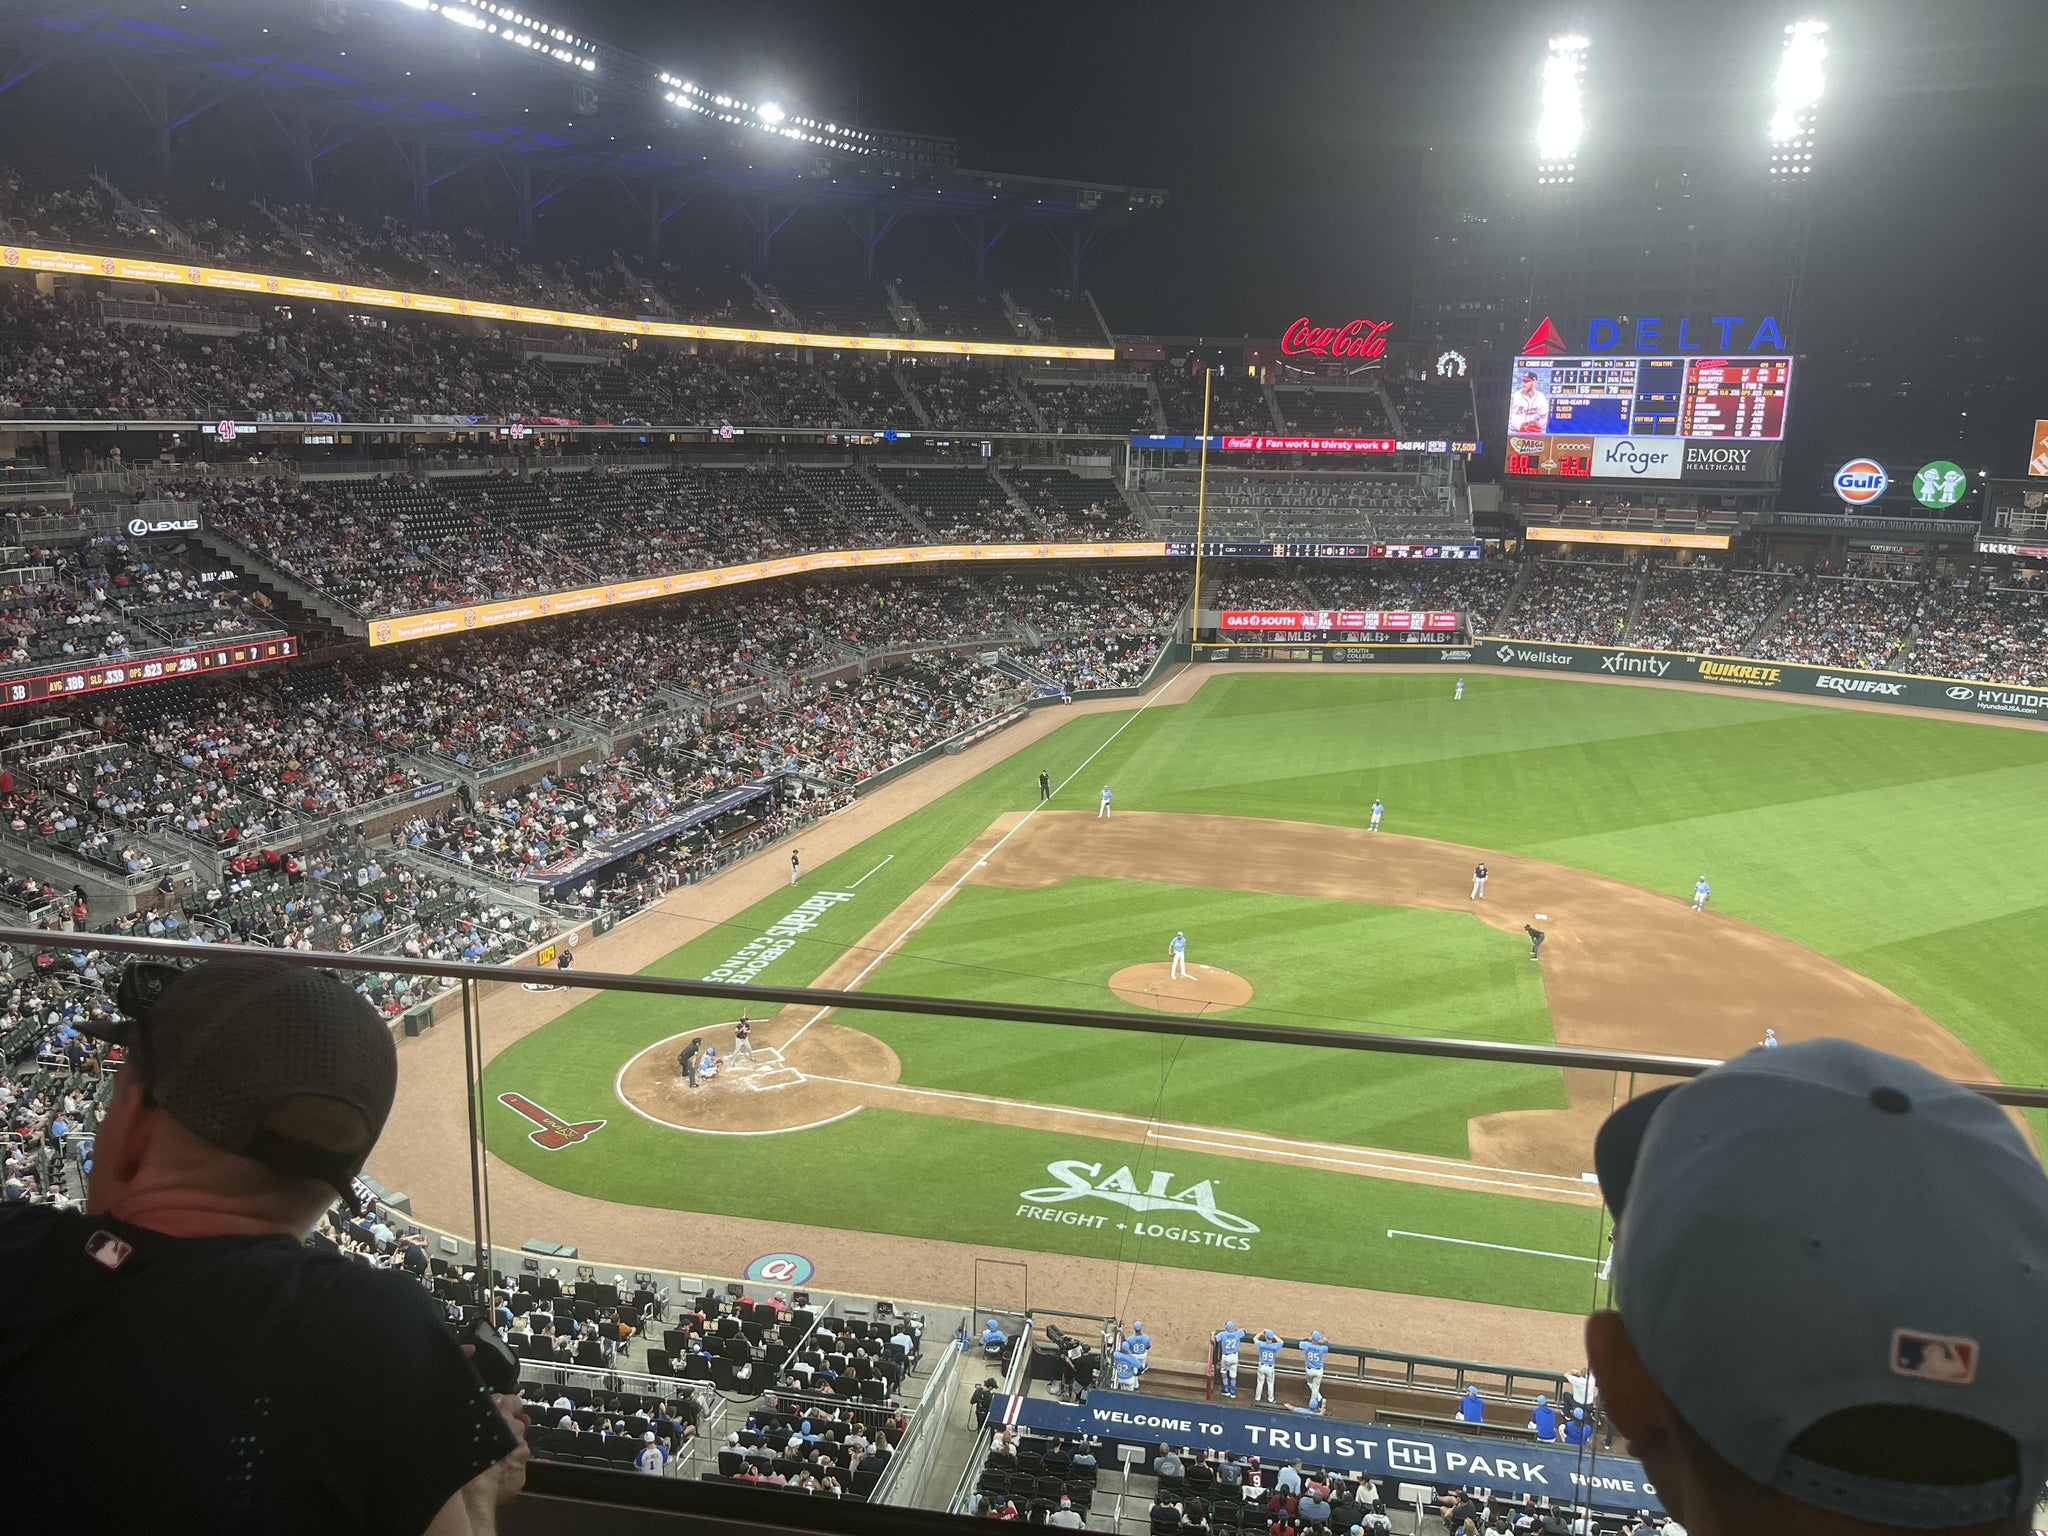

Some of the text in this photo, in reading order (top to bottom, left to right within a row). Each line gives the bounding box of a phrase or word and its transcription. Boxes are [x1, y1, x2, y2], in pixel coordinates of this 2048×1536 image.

[1282, 317, 1394, 357] Coca-Cola
[1588, 316, 1785, 350] DELTA
[218, 421, 236, 439] 41
[510, 424, 524, 439] 44
[884, 430, 898, 441] 42
[1266, 439, 1378, 450] Fan work is thirsty work
[1412, 442, 1425, 450] PM
[1606, 441, 1669, 474] Kroger
[1687, 448, 1752, 464] EMORY
[1837, 474, 1883, 489] Gulf
[148, 520, 198, 531] LEXUS
[1227, 616, 1295, 626] GAS SOUTH
[1302, 616, 1316, 626] AL
[1288, 632, 1318, 642] MLB+
[1360, 632, 1390, 642] MLB+
[1420, 632, 1452, 643] MLB+
[234, 647, 258, 660] RBI 7
[268, 642, 290, 656] HR 2
[204, 652, 227, 666] H 11
[1517, 650, 1573, 664] Wellstar
[129, 662, 162, 678] OPS .623
[165, 658, 198, 672] OBP .284
[1601, 652, 1671, 677] xfinity
[1698, 660, 1781, 681] QUIKRETE
[49, 676, 84, 692] AVG .186
[90, 669, 124, 685] SLG .339
[1719, 676, 1746, 684] America's
[12, 684, 26, 700] 3B
[1816, 675, 1902, 696] EQUIFAX
[1978, 690, 2048, 708] HYUNDA
[1976, 702, 2038, 714] HyundaiUSA.com
[420, 785, 442, 796] HYUNDAI
[702, 936, 774, 983] CASINOS
[1020, 1160, 1238, 1218] SAIA
[1016, 1204, 1108, 1229] FREIGHT
[1134, 1222, 1251, 1251] LOGISTICS
[1134, 1344, 1145, 1352] 83
[1225, 1339, 1237, 1349] 22
[1262, 1352, 1274, 1362] 89
[1308, 1352, 1320, 1362] 85
[1092, 1408, 1656, 1495] WELCOME TO TRUIST PARK HOME O
[650, 1460, 654, 1470] 1
[1227, 1469, 1234, 1482] 3
[1252, 1475, 1261, 1487] 9
